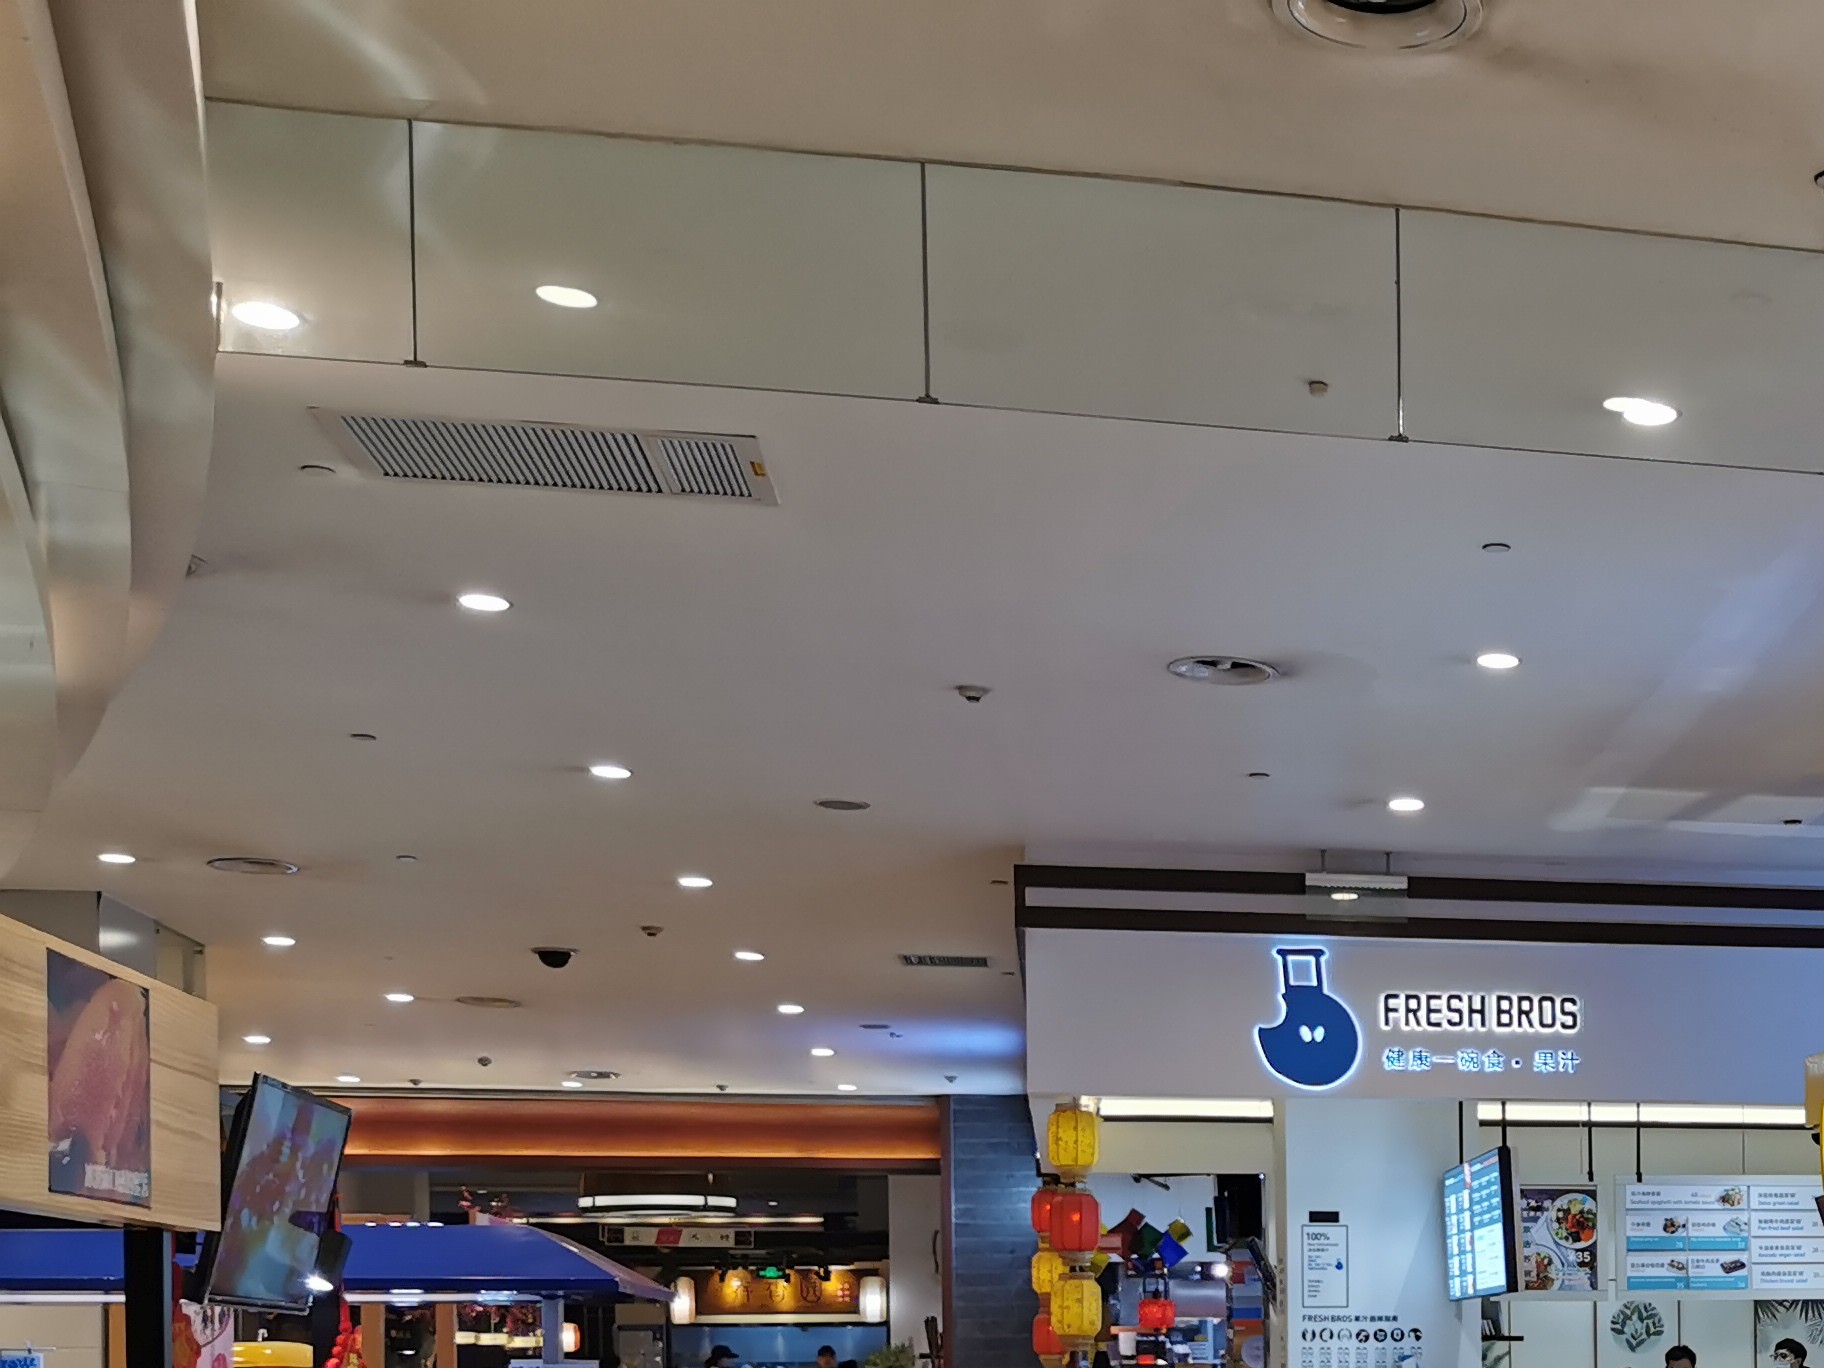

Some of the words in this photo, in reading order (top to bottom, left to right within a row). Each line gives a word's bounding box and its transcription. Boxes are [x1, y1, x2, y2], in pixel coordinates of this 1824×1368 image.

[1382, 992, 1487, 1028] FRESH
[1495, 995, 1580, 1031] BROS
[1305, 1232, 1330, 1241] 100%
[1575, 1251, 1591, 1263] 35
[1302, 1314, 1329, 1322] FRESH
[1331, 1314, 1353, 1322] BROS
